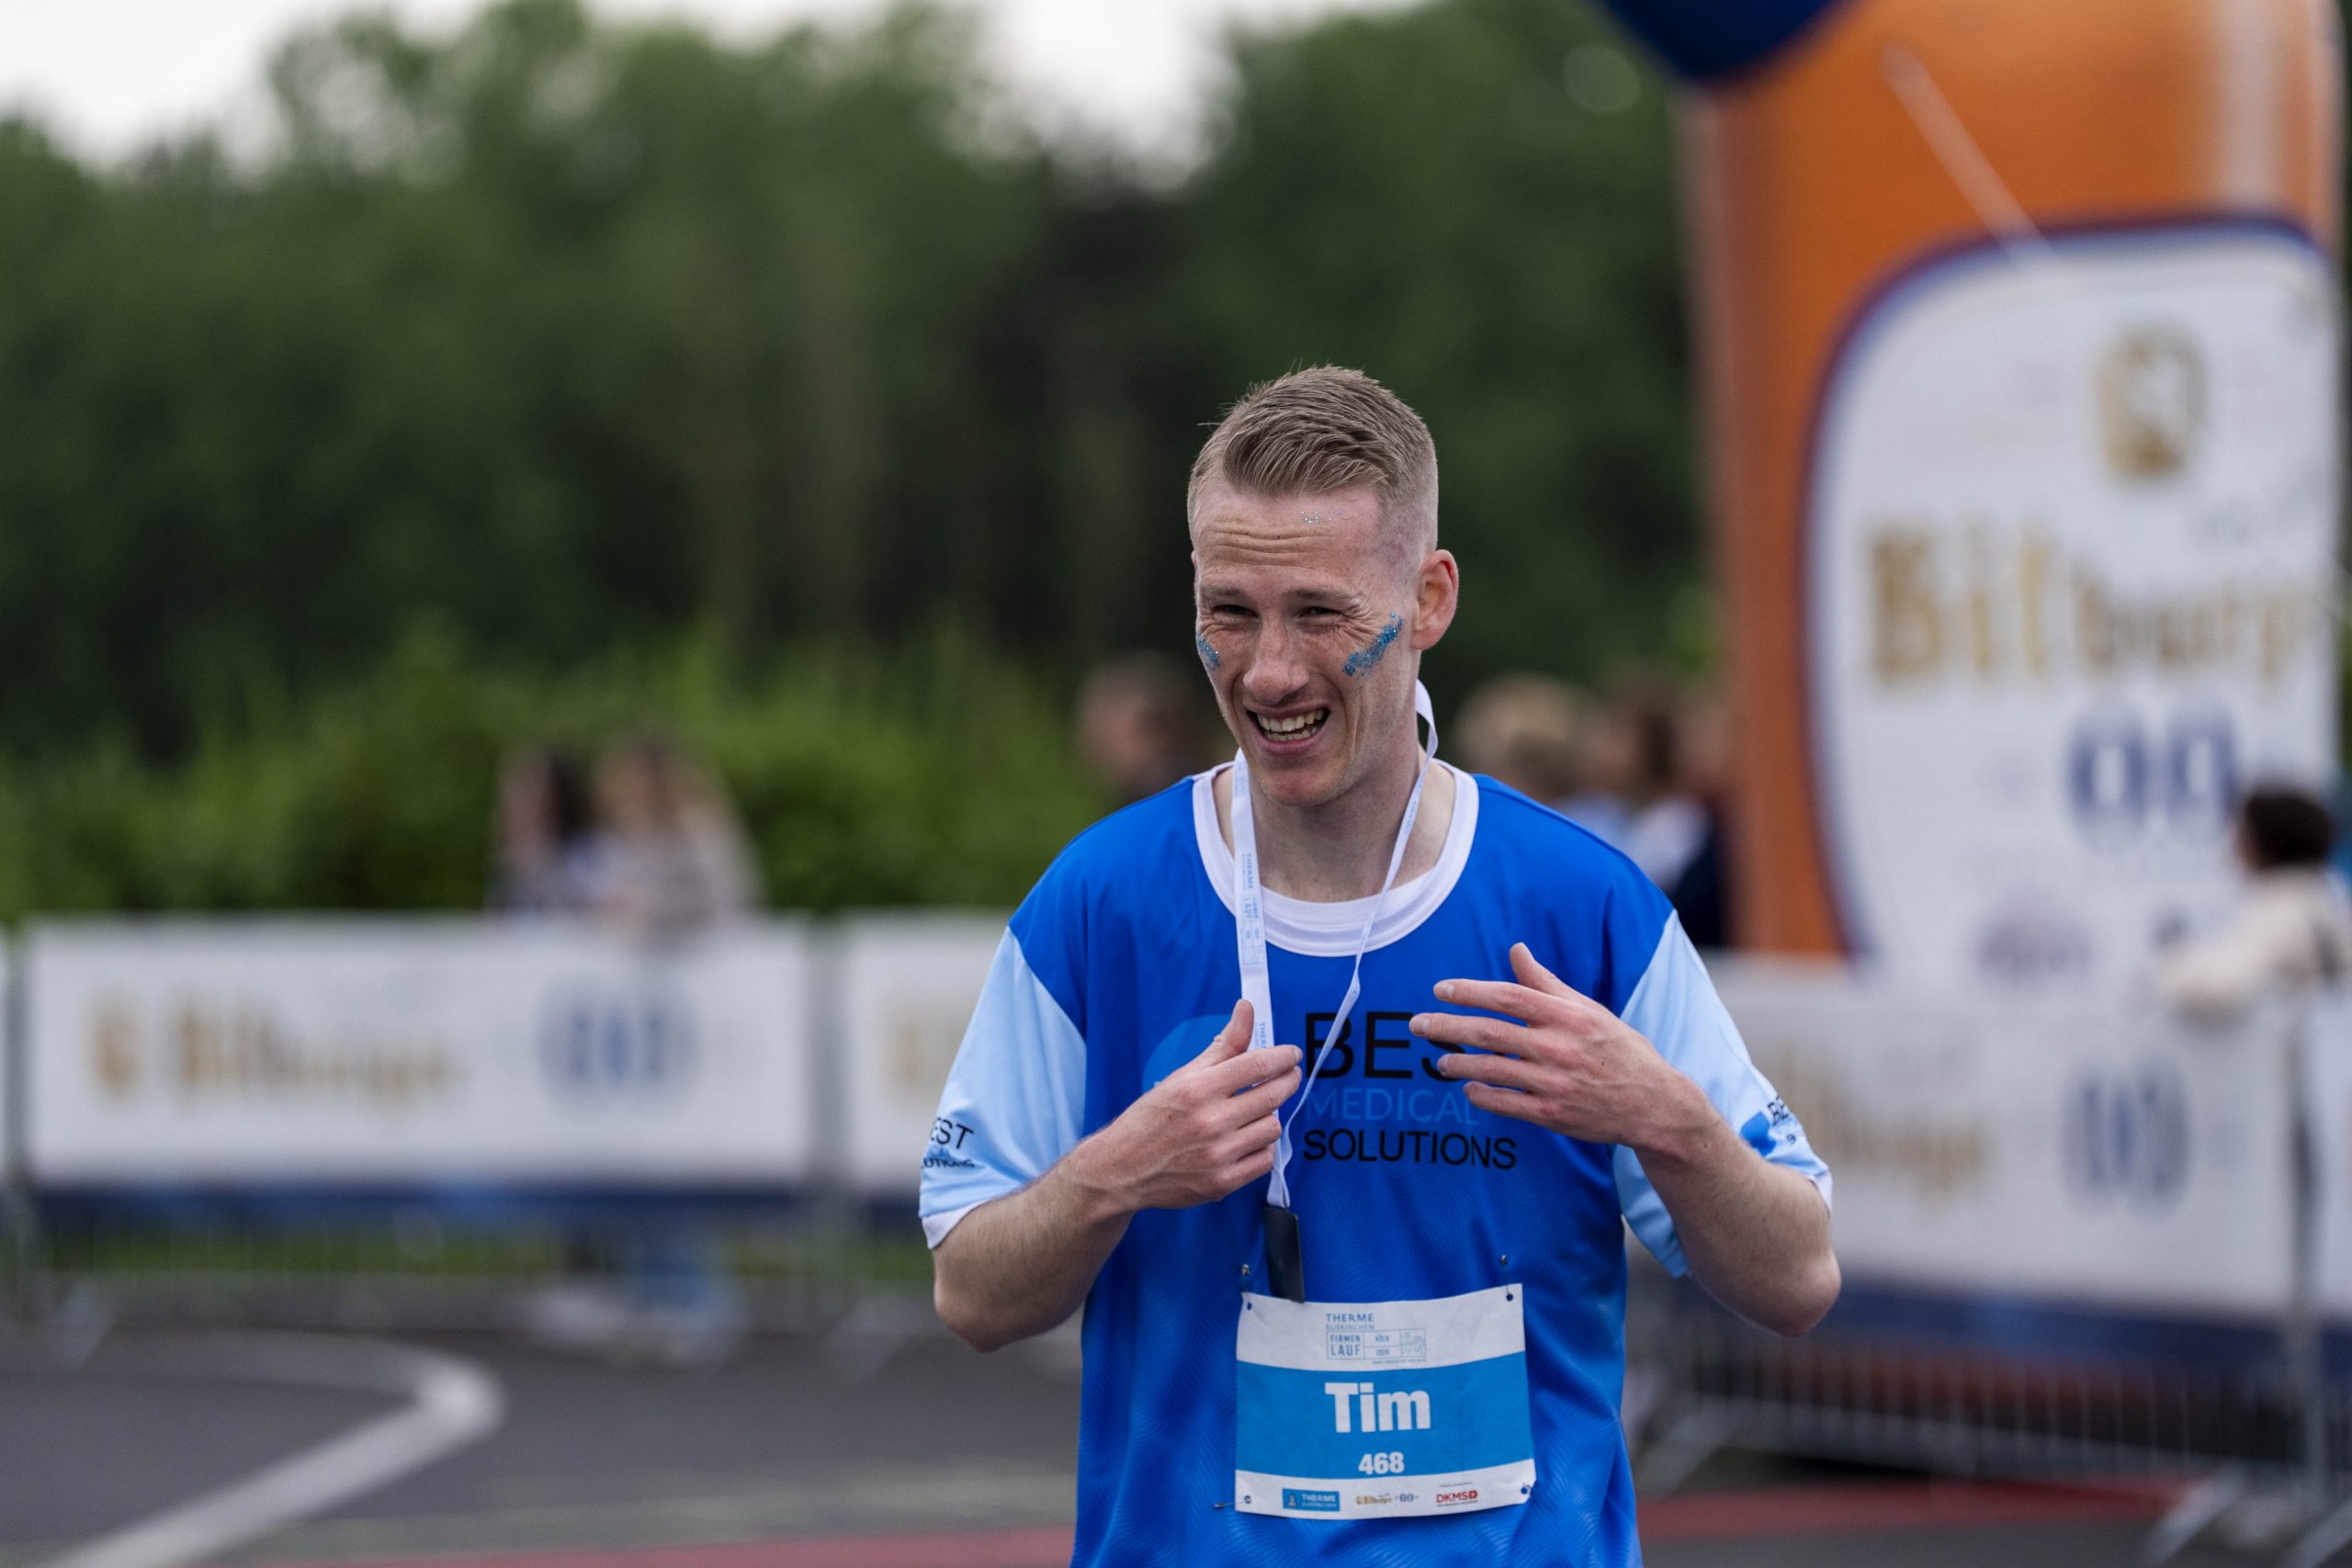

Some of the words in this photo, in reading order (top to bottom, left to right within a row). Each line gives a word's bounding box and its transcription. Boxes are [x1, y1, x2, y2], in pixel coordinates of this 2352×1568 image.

[1306, 1088, 1479, 1126] MEDICAL
[1303, 1128, 1518, 1170] SOLUTIONS
[1326, 1314, 1374, 1322] THERME
[1330, 1335, 1361, 1343] FIRMEN
[1330, 1344, 1361, 1356] LAUF
[1325, 1382, 1430, 1434] Tim
[1358, 1451, 1405, 1475] 468
